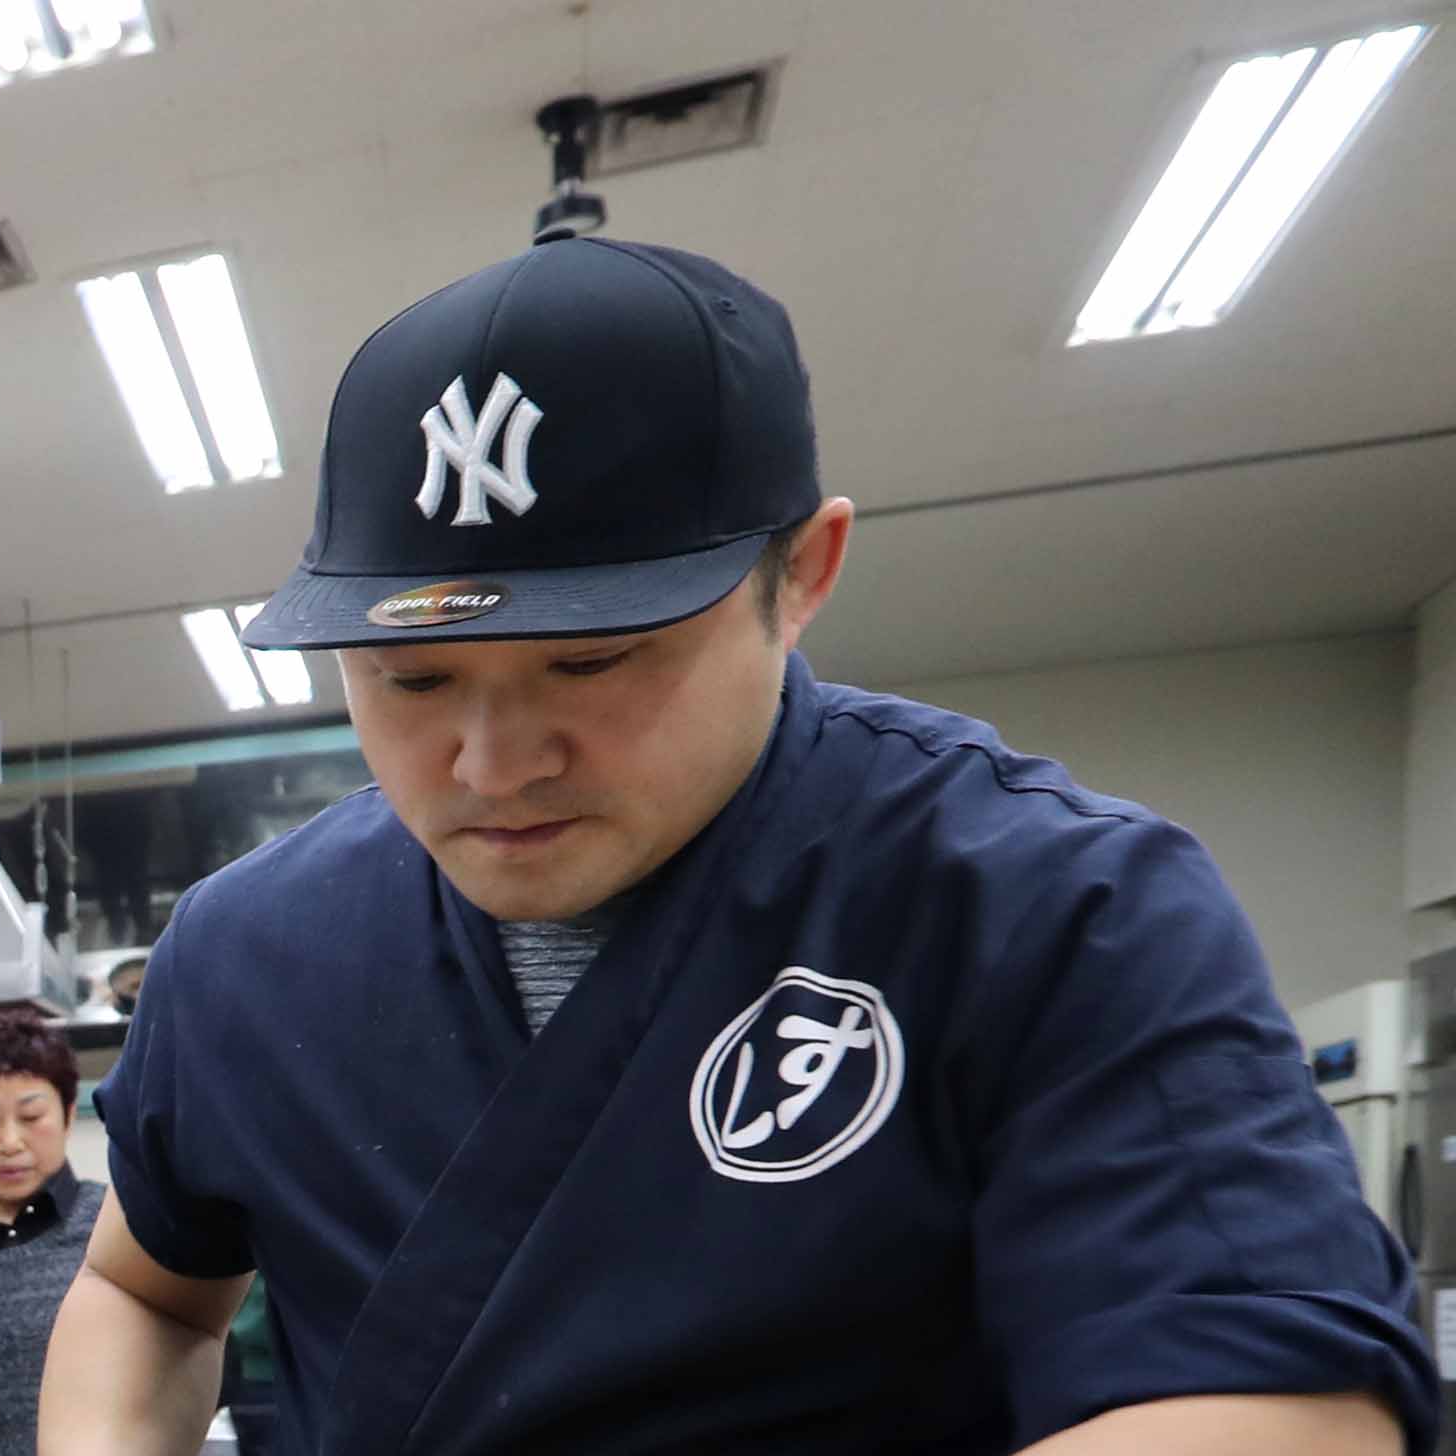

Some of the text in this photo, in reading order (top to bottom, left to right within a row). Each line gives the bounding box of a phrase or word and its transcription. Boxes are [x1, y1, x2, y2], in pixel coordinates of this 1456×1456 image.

[414, 371, 545, 527] NY
[382, 594, 502, 612] COOL FIELD
